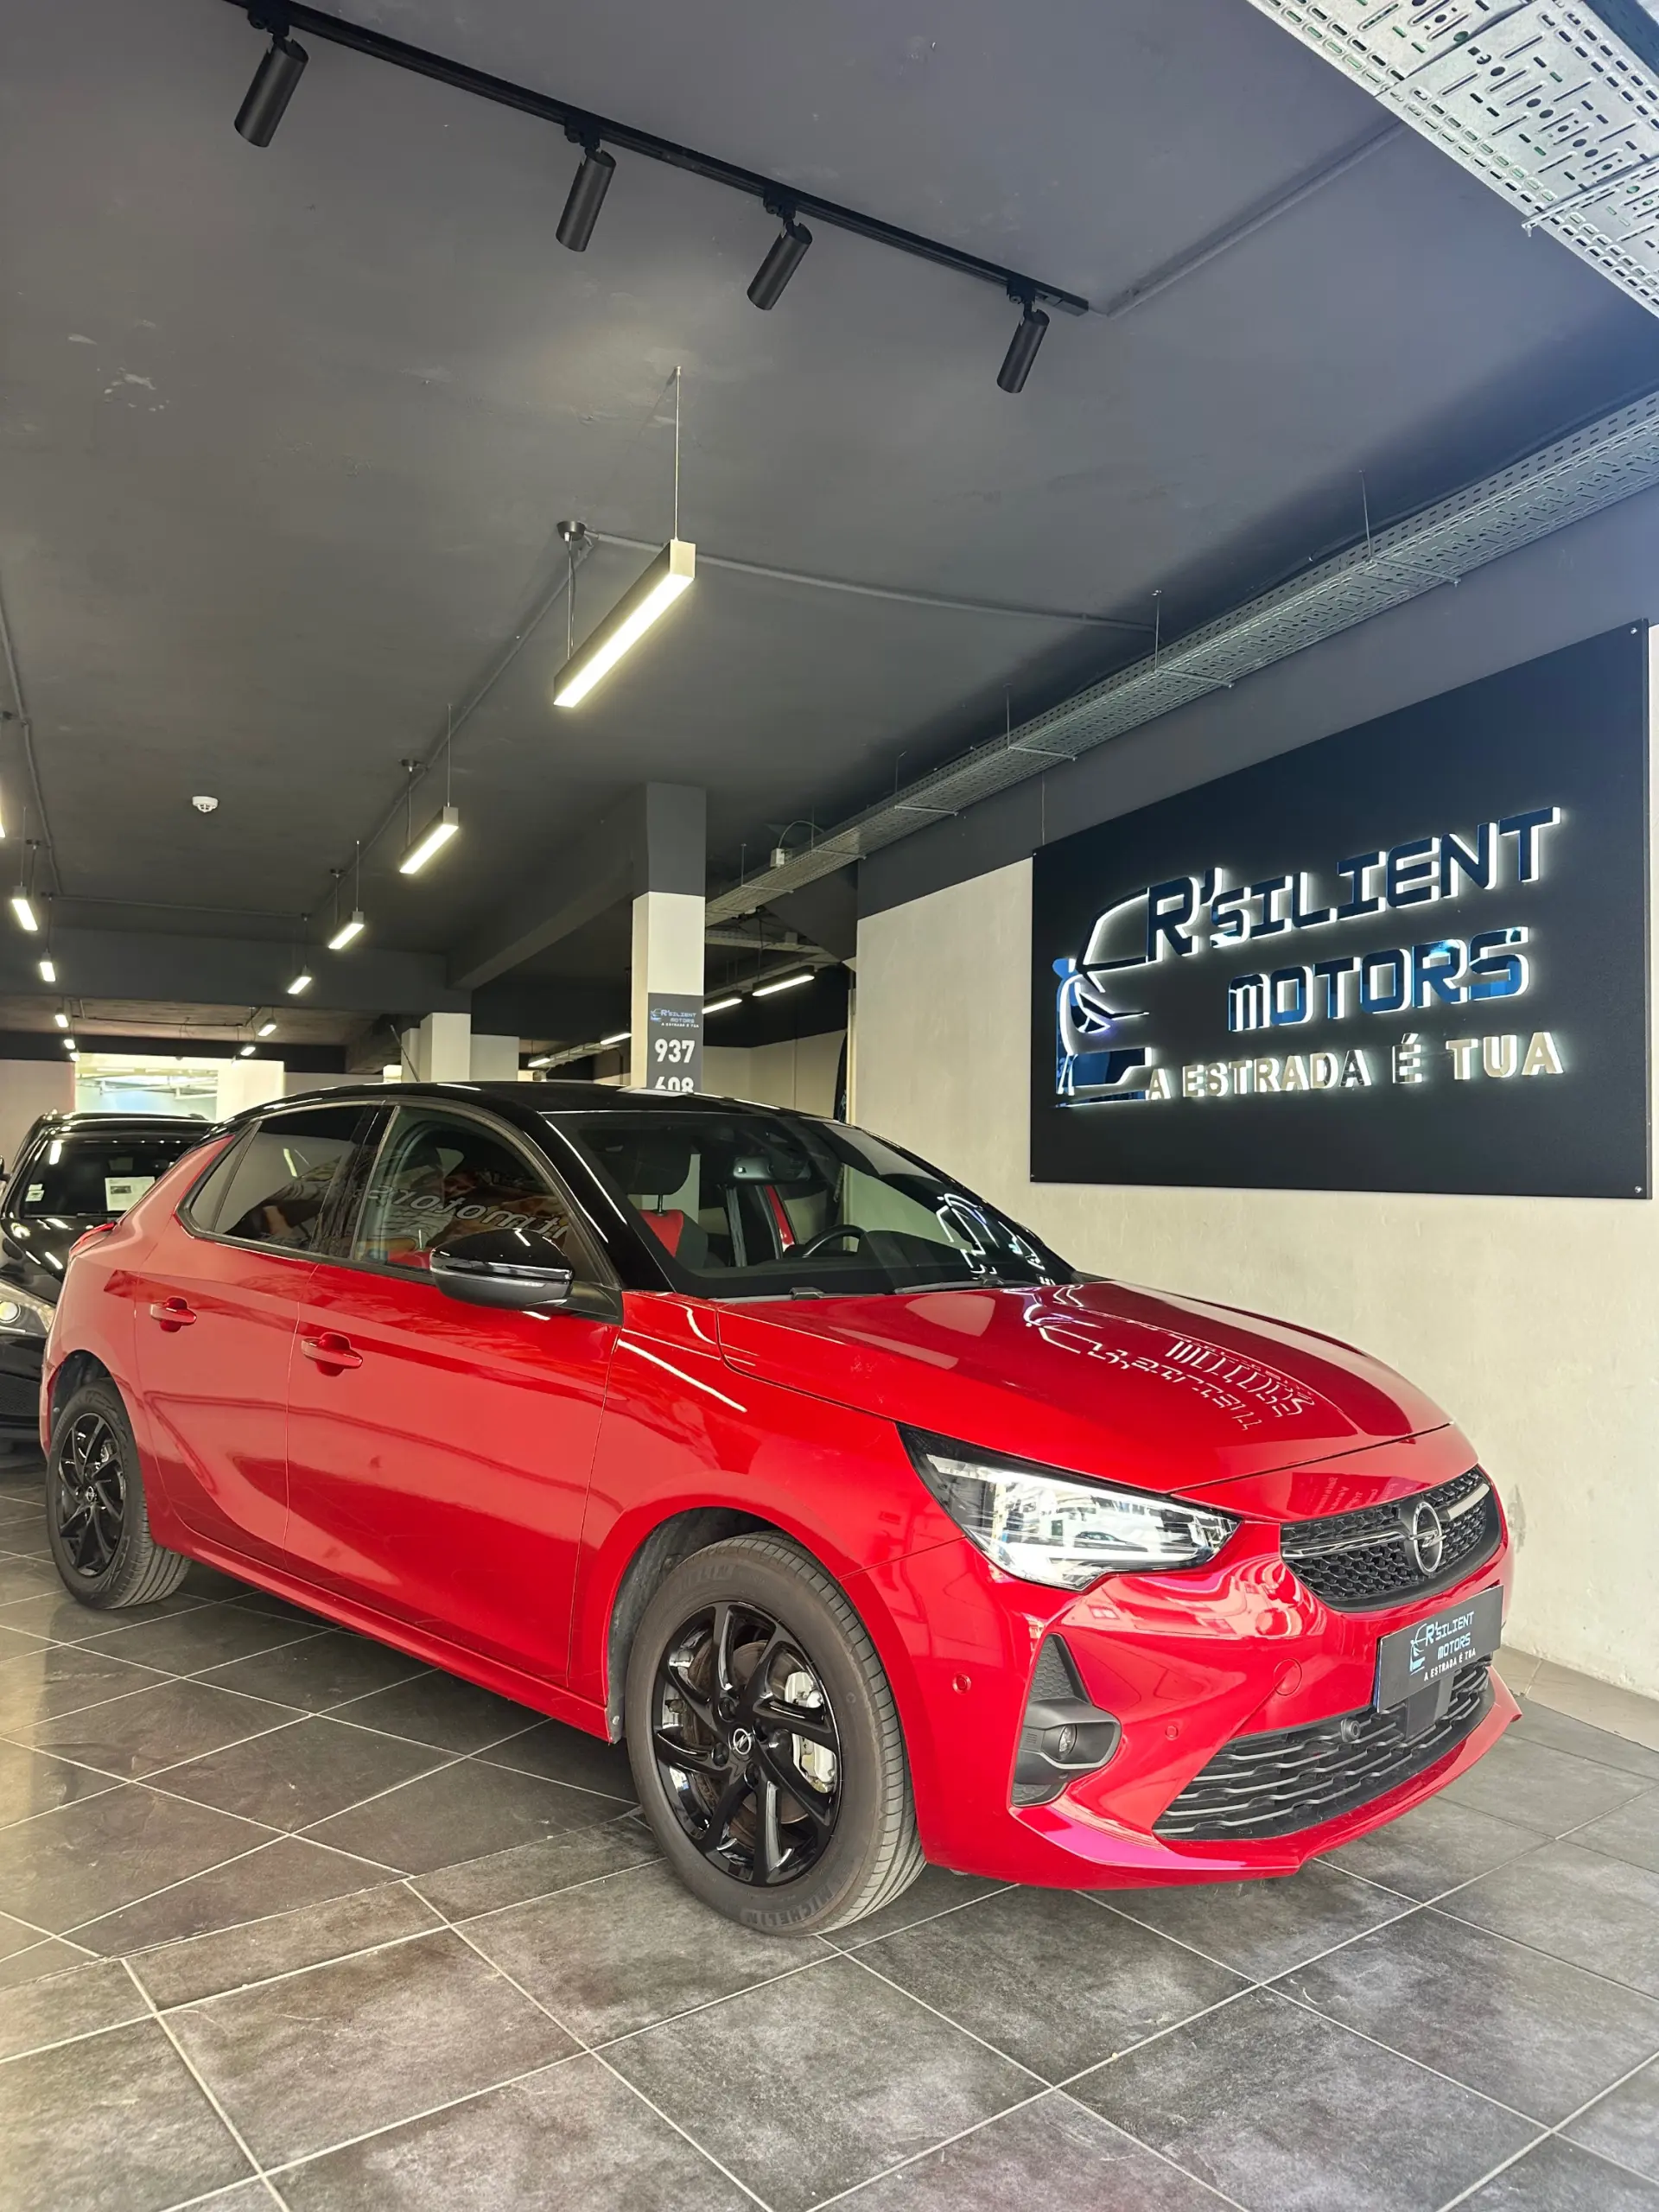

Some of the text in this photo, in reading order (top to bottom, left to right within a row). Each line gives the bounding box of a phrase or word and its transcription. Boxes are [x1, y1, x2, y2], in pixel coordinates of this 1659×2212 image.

[1146, 806, 1560, 959] R'SILIENT
[1227, 926, 1529, 1033] MOTORS
[655, 1039, 695, 1063] 937
[1145, 1031, 1565, 1101] A ESTRADA É TUA
[1426, 1611, 1474, 1646] R'SILIENT
[1438, 1632, 1471, 1660] MOTORS
[1424, 1671, 1429, 1681] A
[1431, 1657, 1457, 1677] ESTRADA
[1459, 1652, 1463, 1662] É
